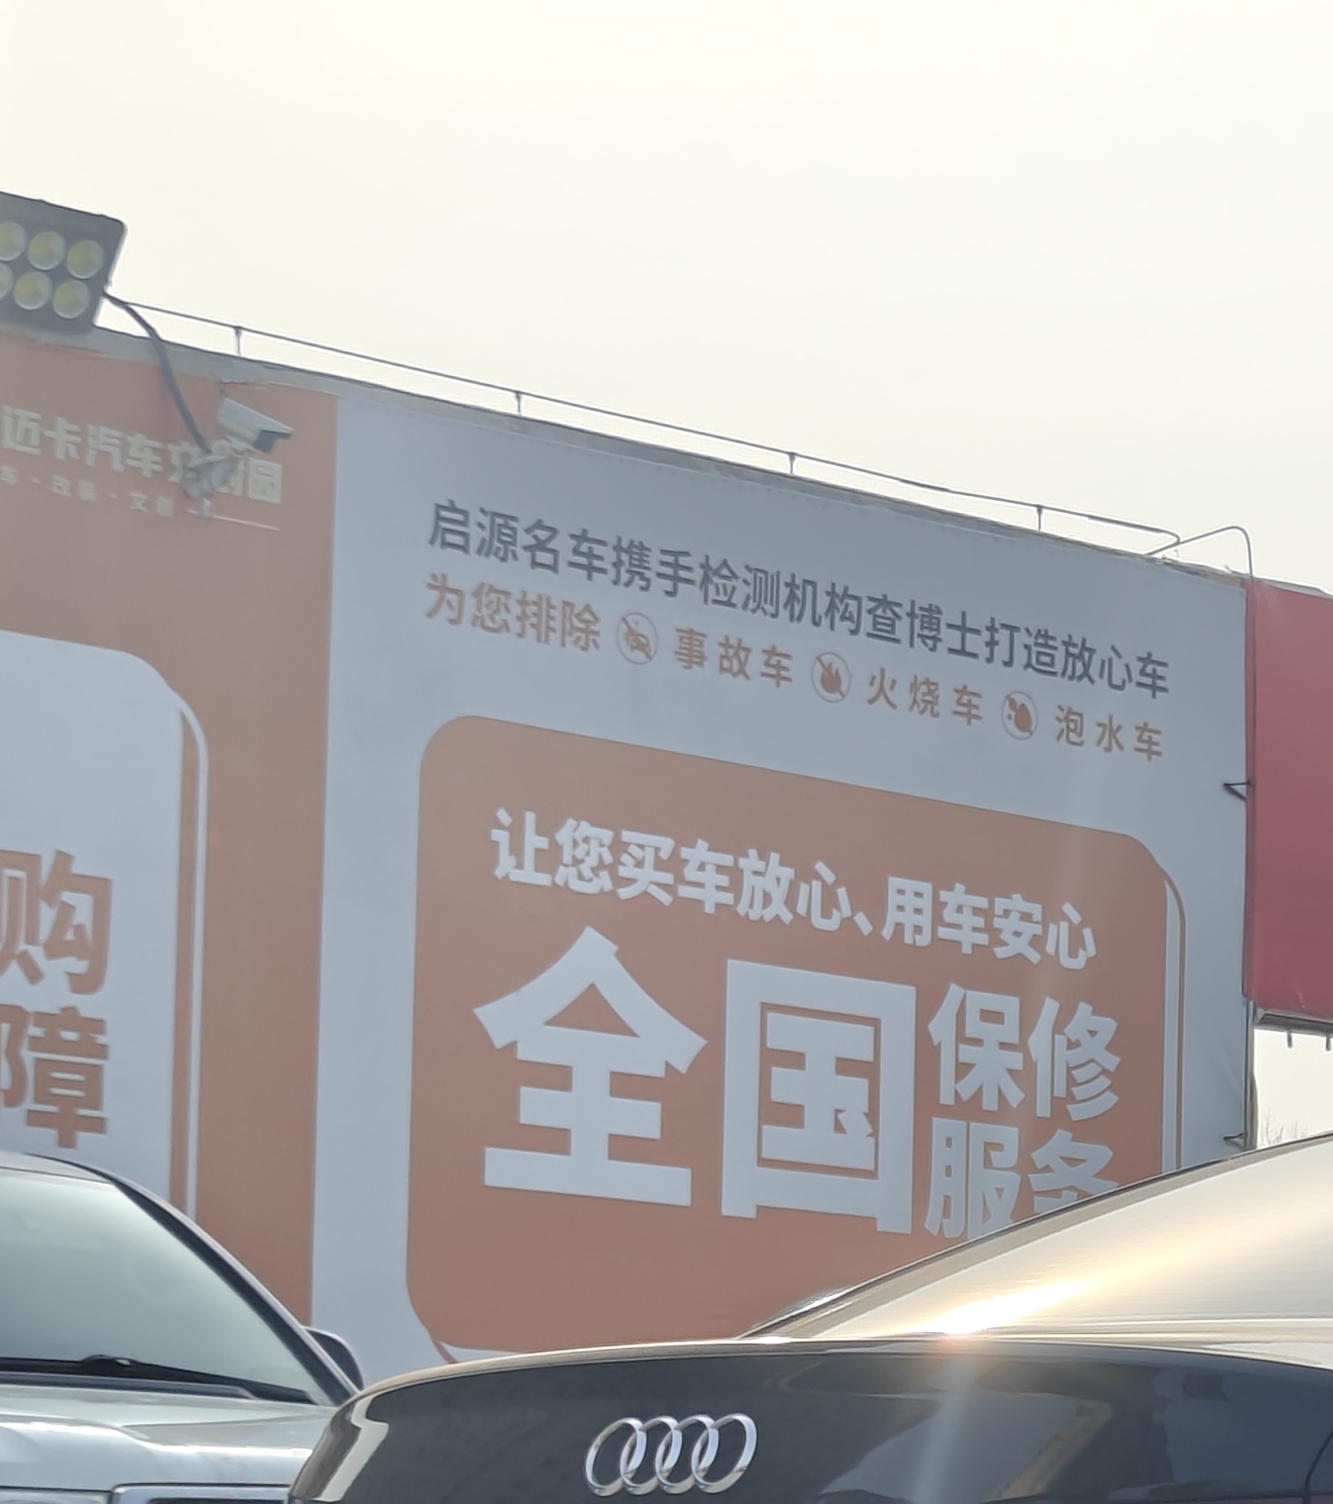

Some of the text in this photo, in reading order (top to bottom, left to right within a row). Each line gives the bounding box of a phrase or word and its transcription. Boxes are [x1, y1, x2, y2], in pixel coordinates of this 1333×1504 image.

[2, 405, 283, 504] 迈卡汽车文园
[426, 573, 1163, 762] 为您排除 事故车 火烧车 泡水车
[429, 499, 1170, 699] 启源名车携手检测机构查博士打造放心车
[490, 808, 1097, 969] 让您买车放心、用车安心
[472, 925, 917, 1235] 全国
[928, 982, 1121, 1121] 保修
